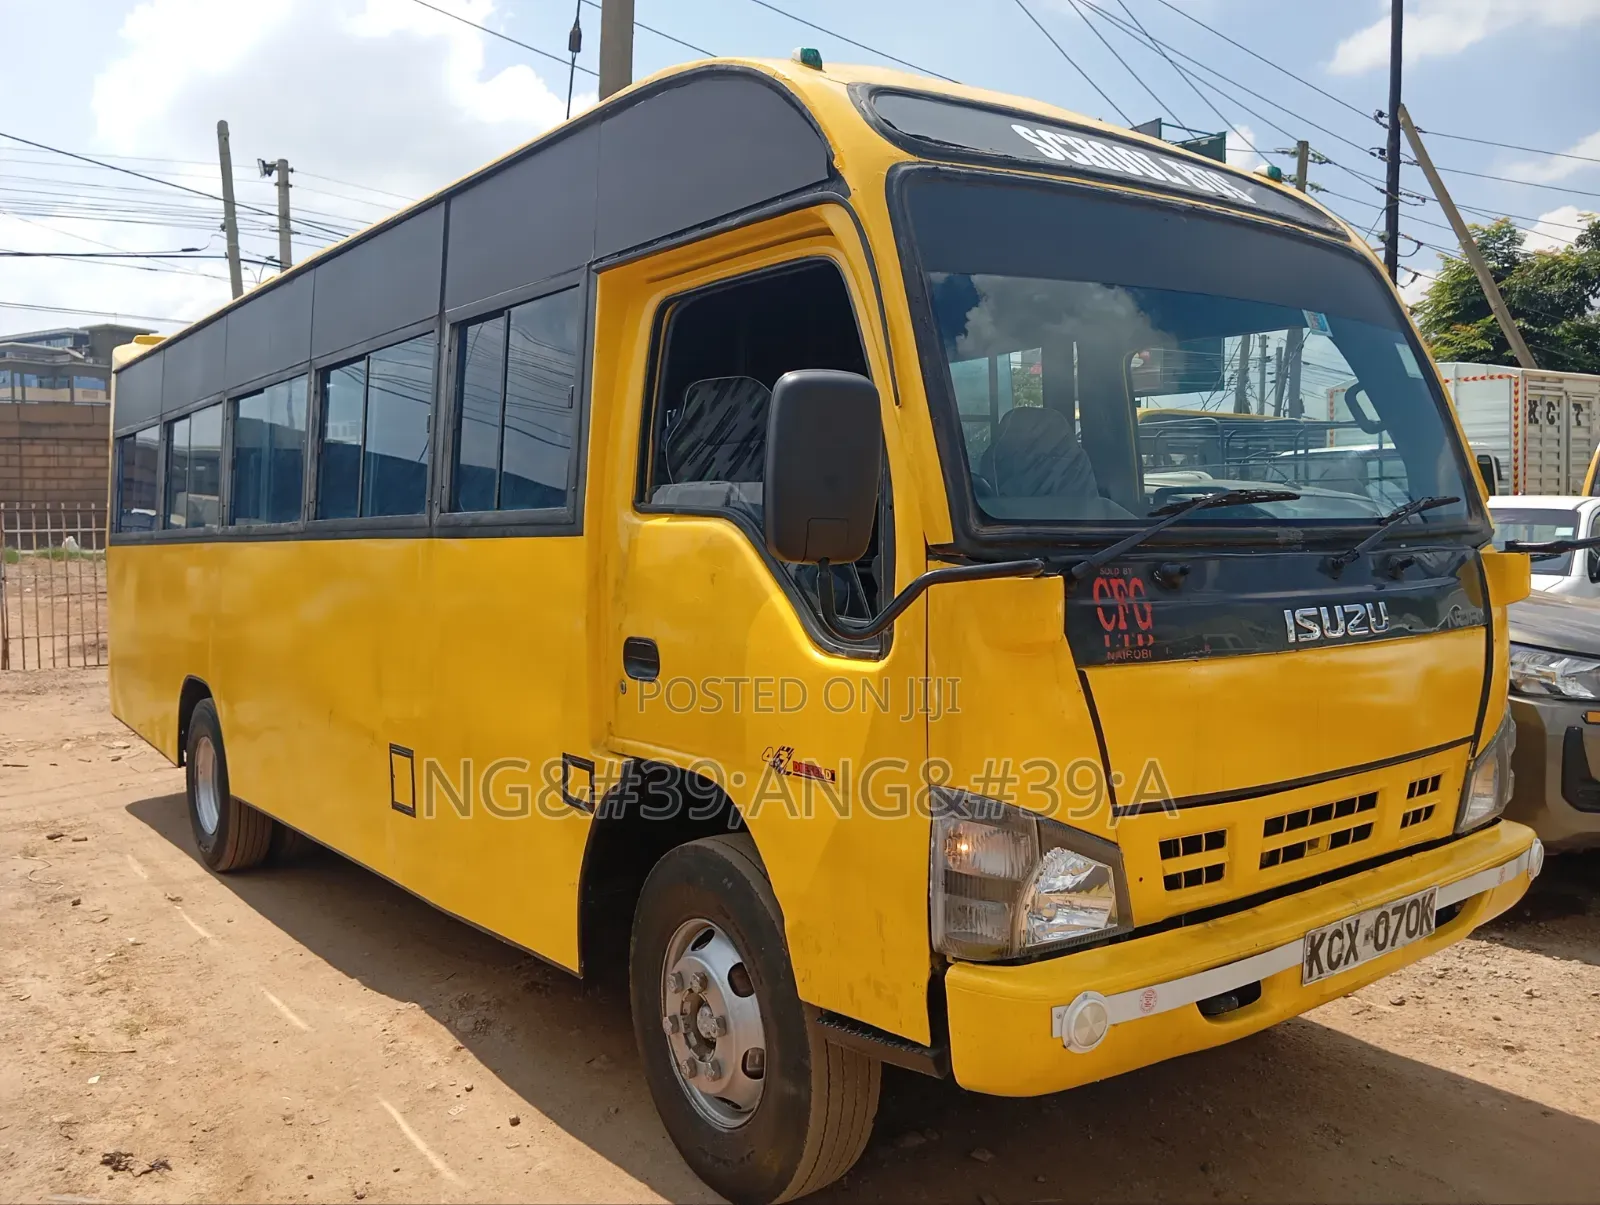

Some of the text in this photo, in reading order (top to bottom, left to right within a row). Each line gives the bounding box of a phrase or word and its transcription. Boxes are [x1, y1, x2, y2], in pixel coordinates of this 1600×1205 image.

[1011, 124, 1257, 204] SCHOOL BUS
[1100, 567, 1132, 575] SOLD BY
[1284, 601, 1389, 643] ISUZU
[1107, 649, 1152, 660] NAIROBI
[1307, 892, 1435, 979] KCX 070K
